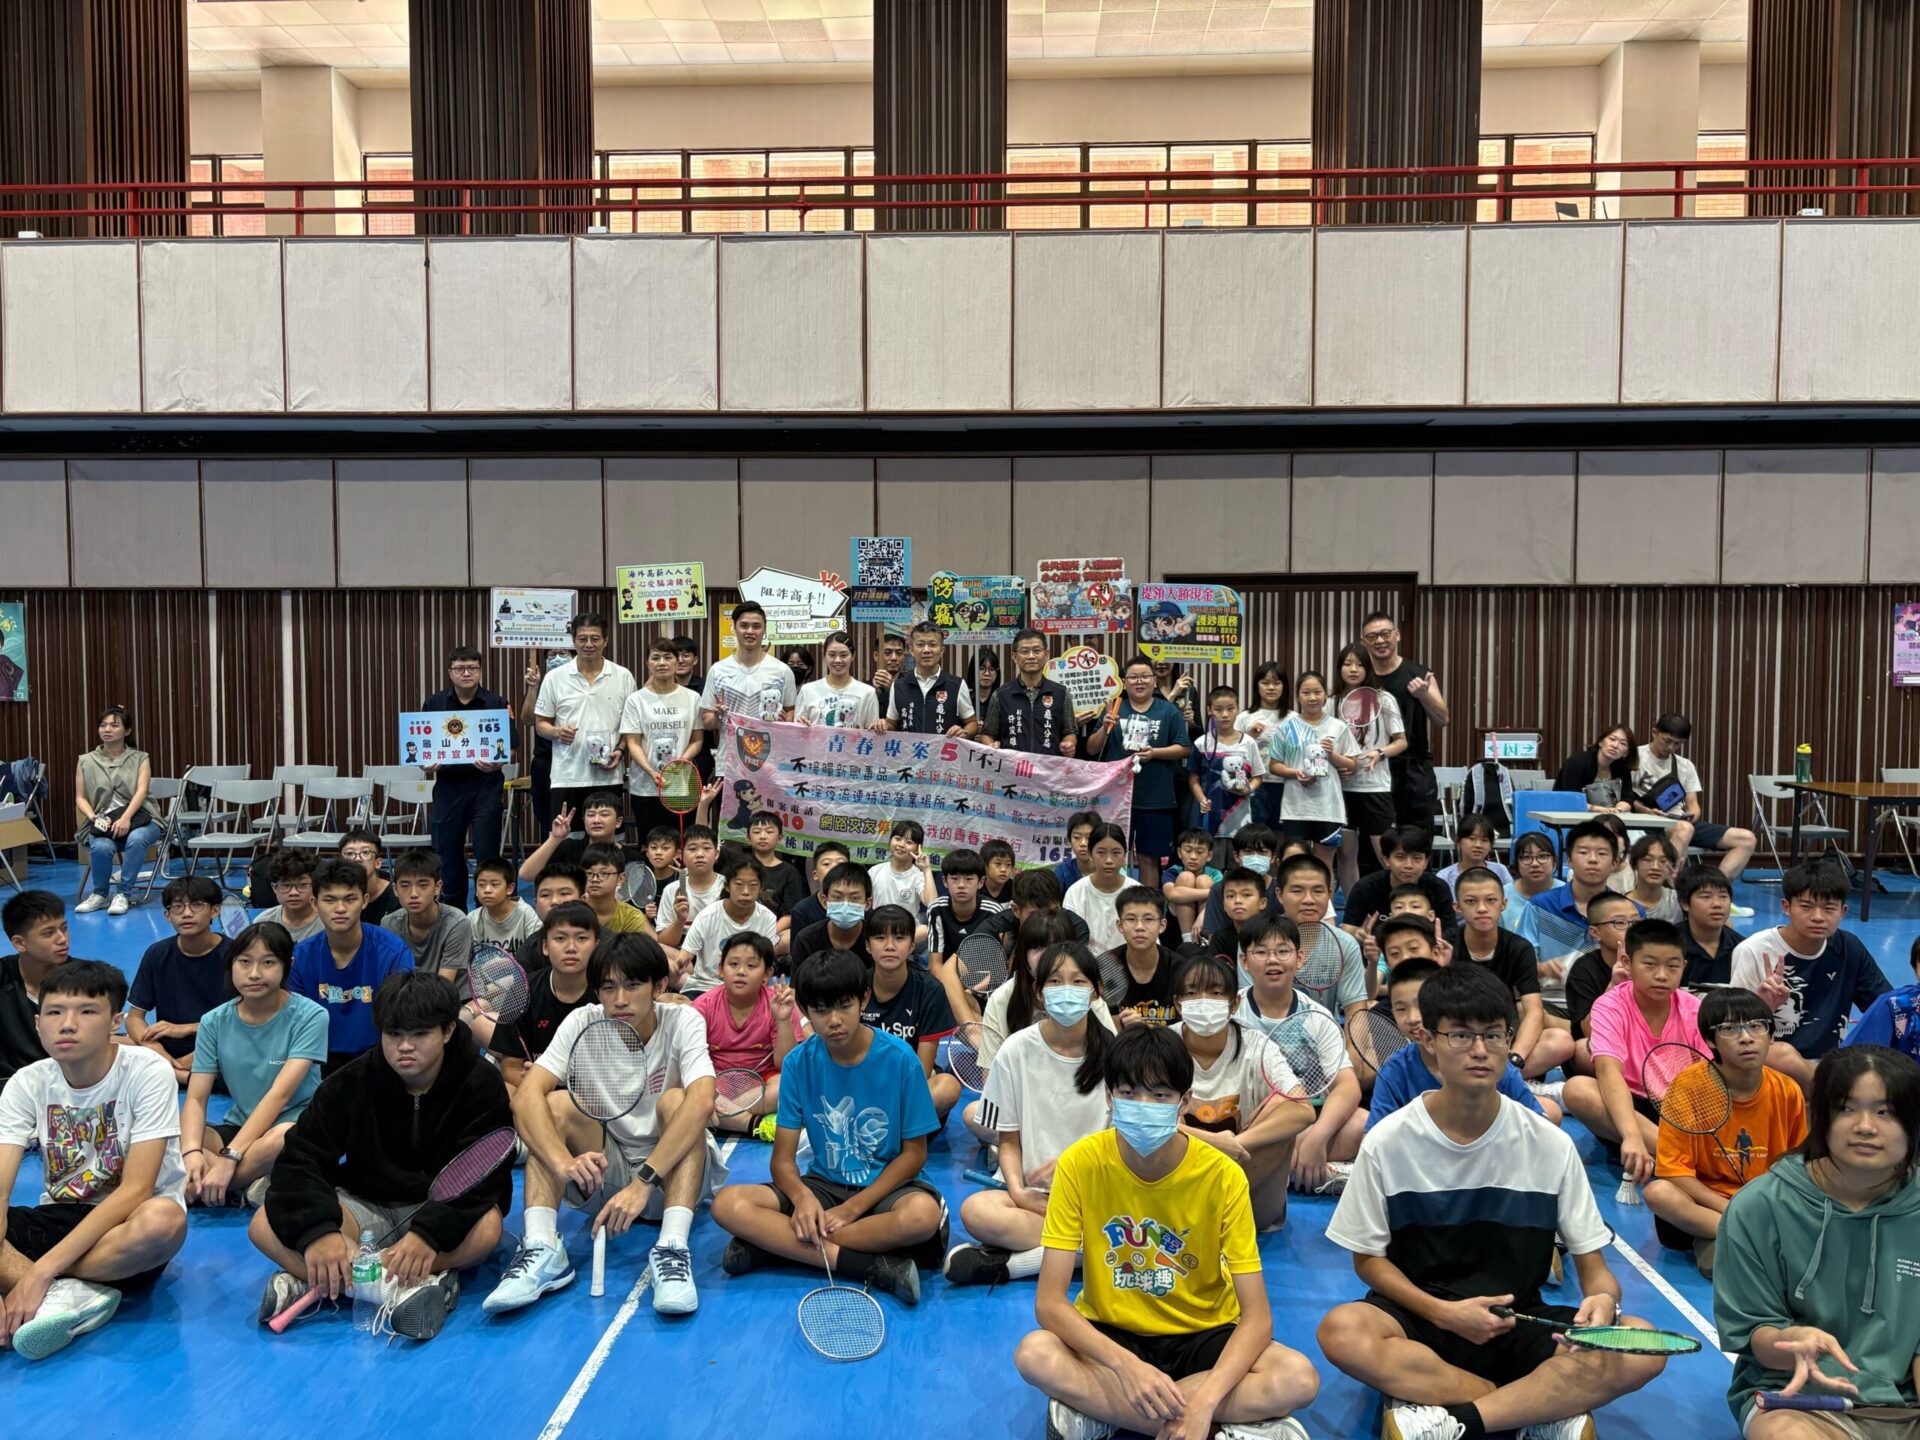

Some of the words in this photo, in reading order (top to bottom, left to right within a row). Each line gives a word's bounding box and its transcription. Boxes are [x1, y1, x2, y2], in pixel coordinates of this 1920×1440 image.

[760, 586, 826, 605] 阻詐高手!!
[1141, 587, 1214, 601] 提領大額現金
[647, 597, 679, 612] 165
[1221, 635, 1238, 645] 110
[653, 707, 678, 715] MAKE
[935, 704, 946, 733] 龜山分
[409, 726, 433, 735] 110
[478, 723, 501, 733] 165
[645, 721, 688, 731] YOURSELF
[1043, 709, 1053, 749] 龜山分局
[422, 737, 490, 749] 龜山分局
[422, 749, 491, 760] 防詐宣講團
[790, 757, 888, 782] 不接觸新興毒品
[793, 781, 946, 809] 不深夜流連特定營業場所
[767, 798, 813, 816] 報案電話
[1040, 846, 1072, 863] 165
[1114, 1268, 1173, 1291] 玩球趣
